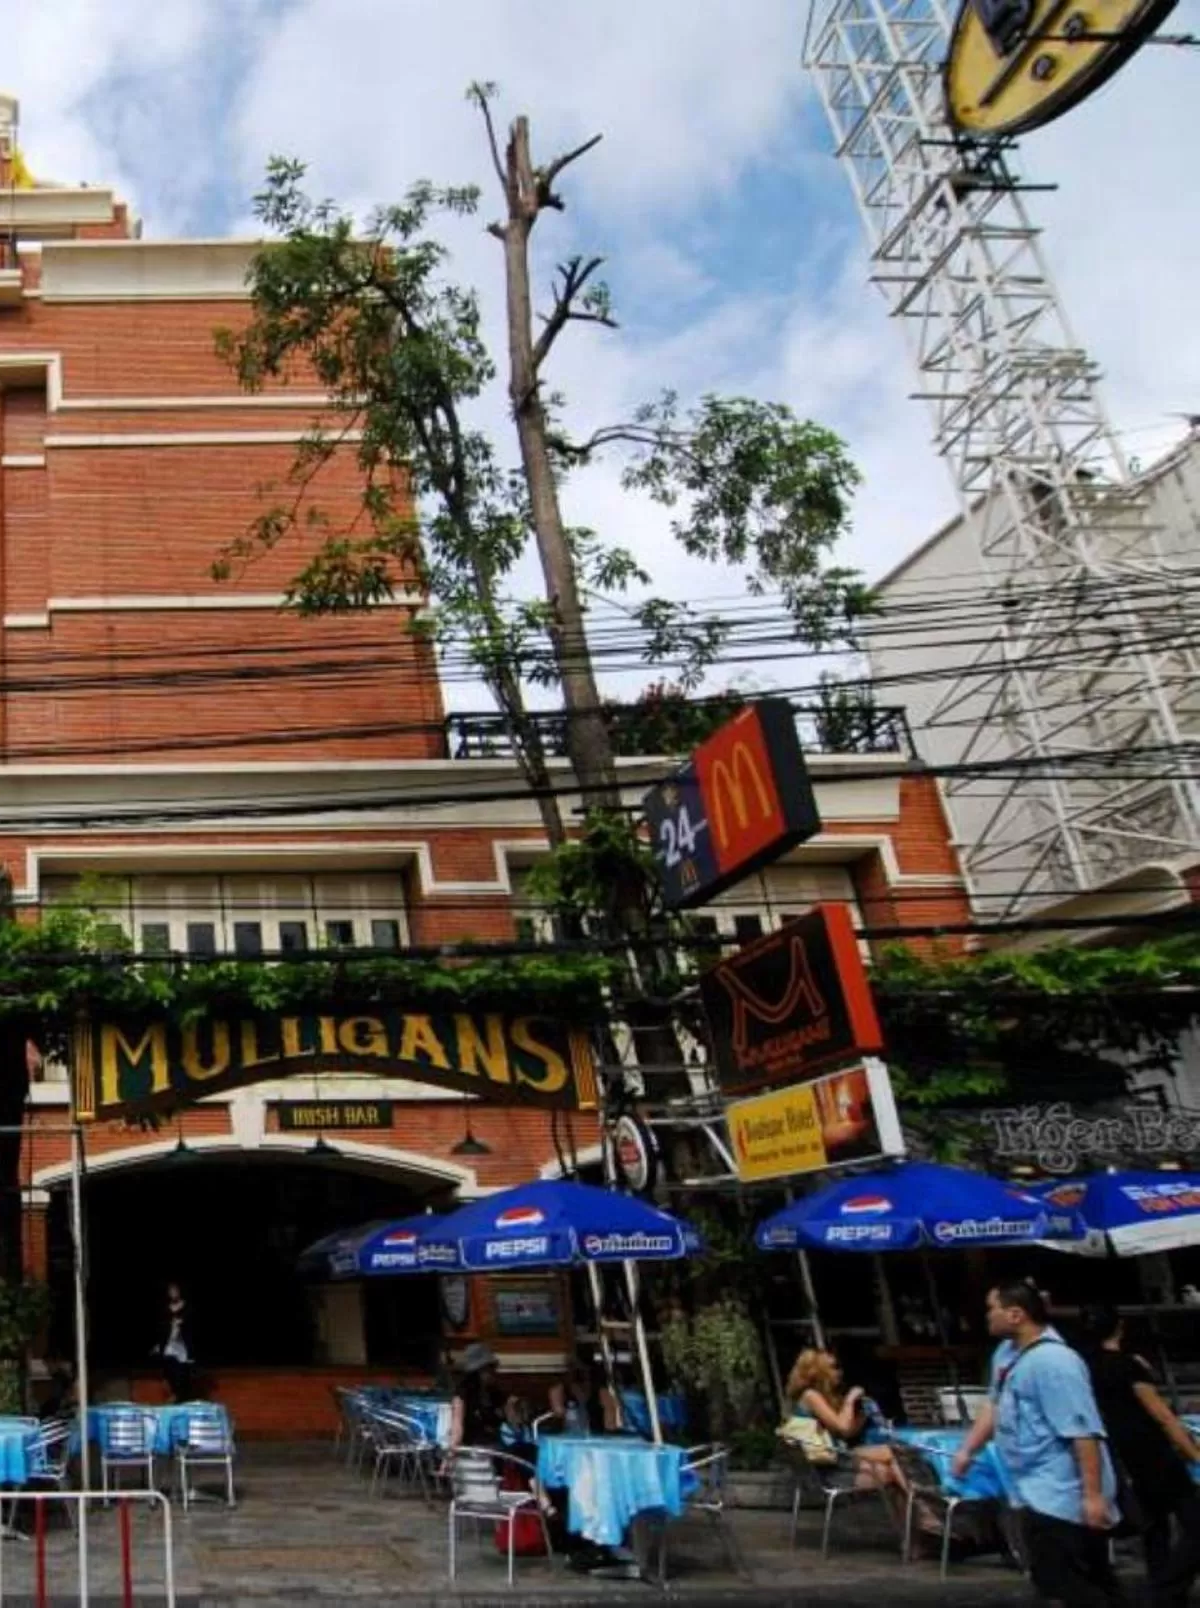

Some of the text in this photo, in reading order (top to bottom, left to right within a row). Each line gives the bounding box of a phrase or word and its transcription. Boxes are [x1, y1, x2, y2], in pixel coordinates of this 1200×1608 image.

[660, 805, 708, 867] 24
[100, 1014, 569, 1106] MULLIGANS
[293, 1105, 380, 1126] IRISH BAR
[980, 1101, 1124, 1174] Tiger
[826, 1224, 892, 1241] PEPSI
[485, 1237, 548, 1259] PEPSI
[371, 1253, 416, 1268] PEPSI
